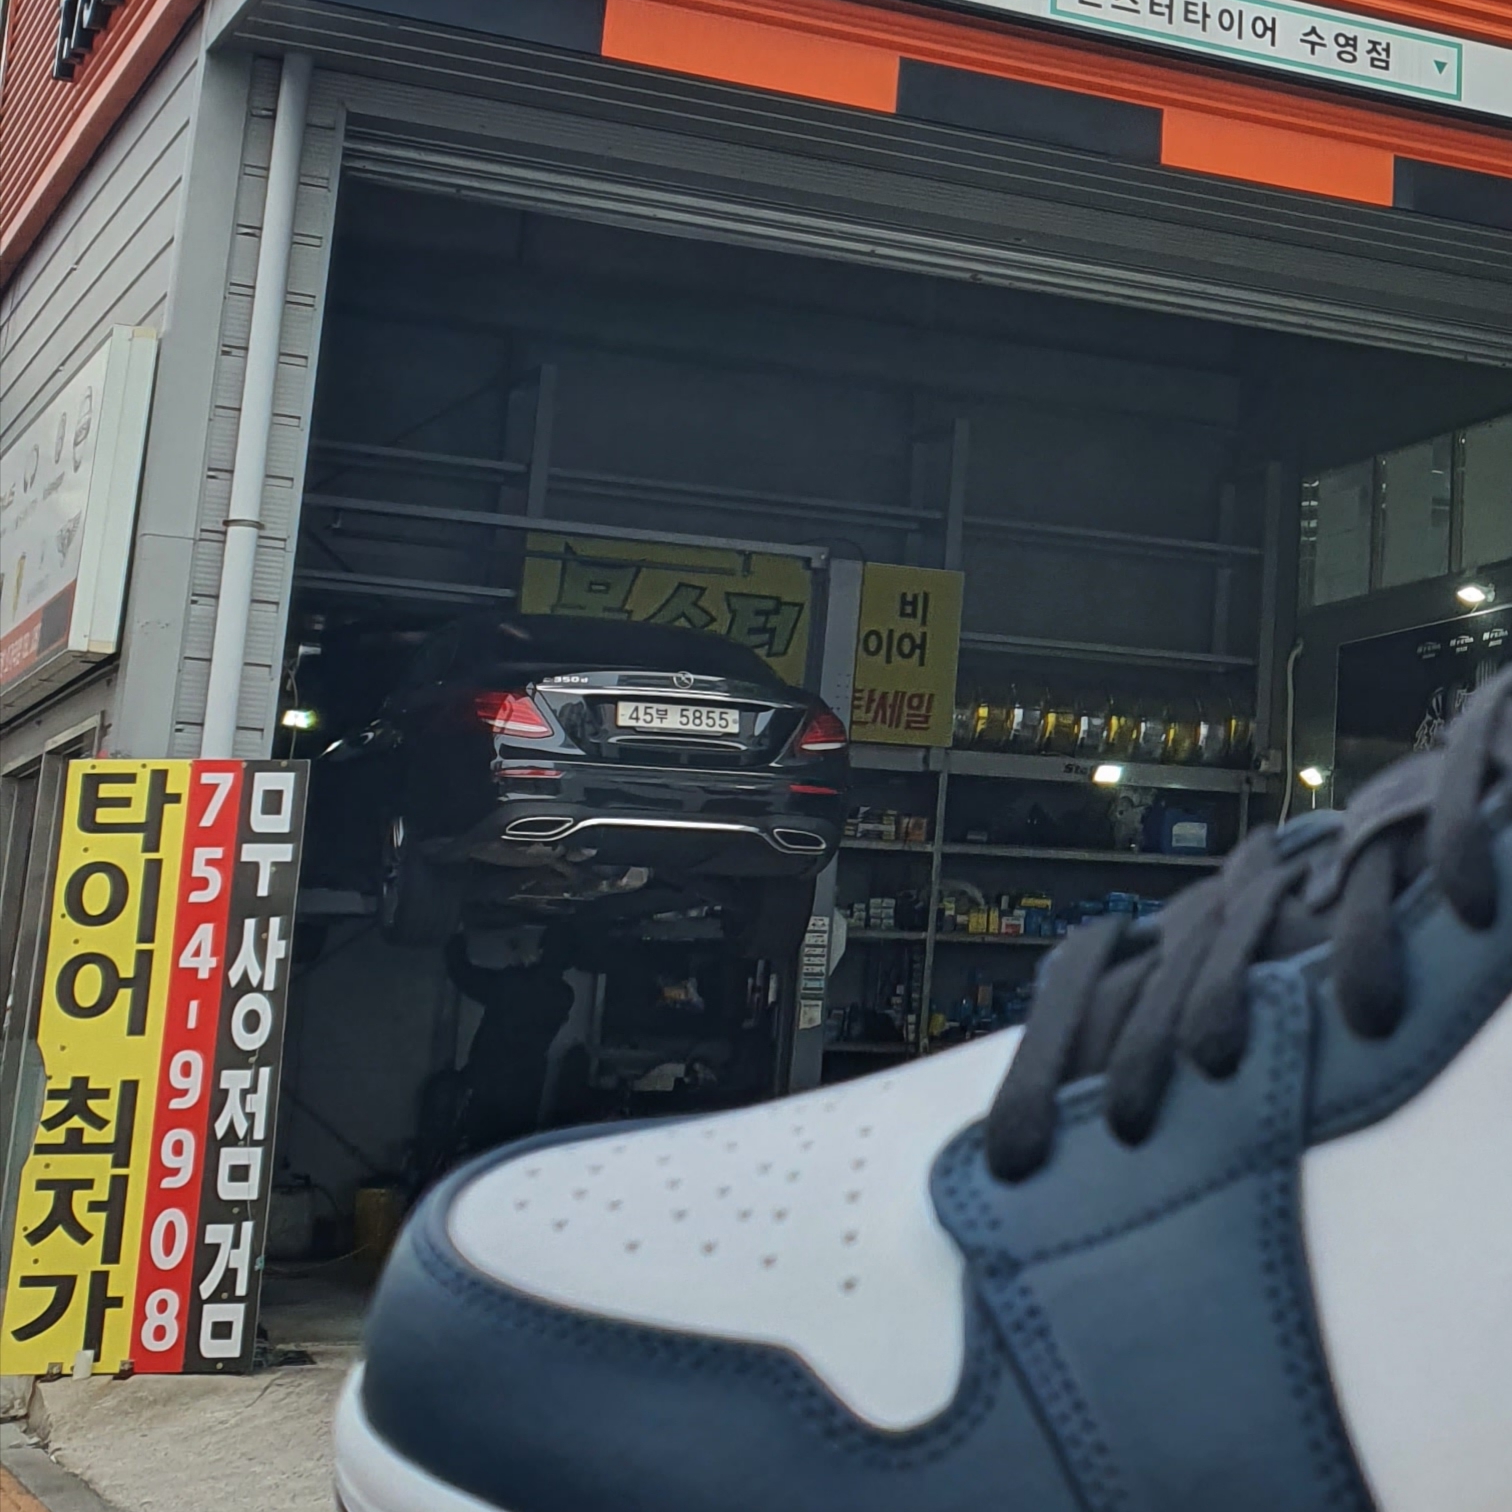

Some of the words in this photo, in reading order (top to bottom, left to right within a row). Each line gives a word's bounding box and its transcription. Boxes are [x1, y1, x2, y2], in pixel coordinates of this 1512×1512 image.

[1298, 24, 1392, 72] 수영점
[628, 705, 669, 725] 45부
[678, 708, 730, 729] 5855
[899, 590, 930, 627] 비
[55, 769, 182, 1038] 타이어
[139, 771, 235, 1354] 754-9908
[198, 771, 296, 1359] 무상점검
[11, 1075, 140, 1364] 최저가
